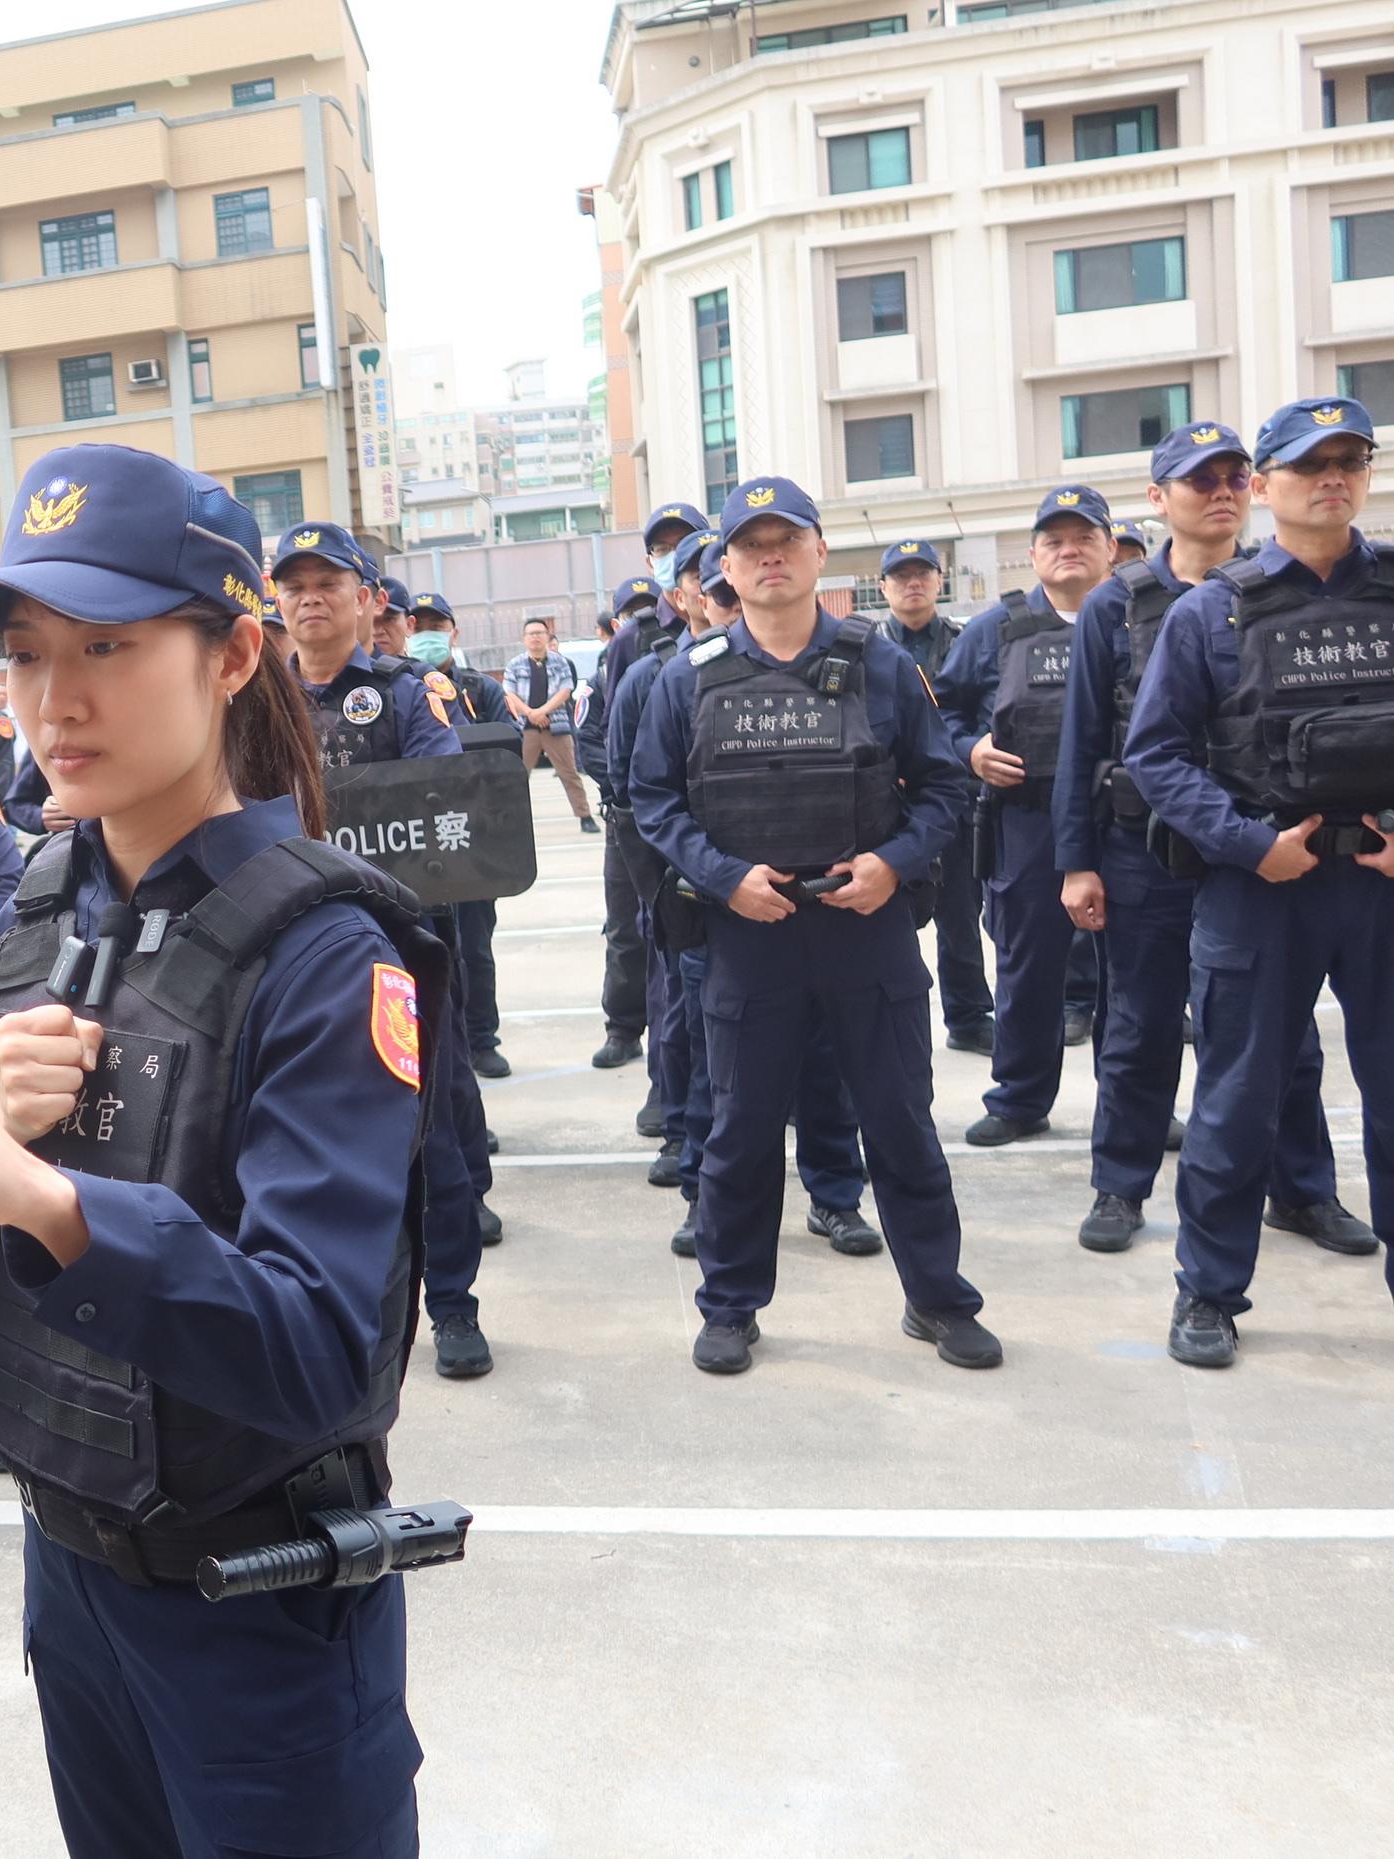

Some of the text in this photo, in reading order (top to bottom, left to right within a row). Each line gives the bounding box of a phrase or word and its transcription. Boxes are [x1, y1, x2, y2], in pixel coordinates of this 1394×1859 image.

[1275, 623, 1394, 642] 彰化縣警察
[1293, 639, 1391, 667] 技術教官
[1310, 671, 1347, 682] Police
[734, 711, 823, 734] 技術教官
[747, 738, 778, 749] Police
[783, 736, 835, 748] Instructor
[434, 811, 471, 851] 察
